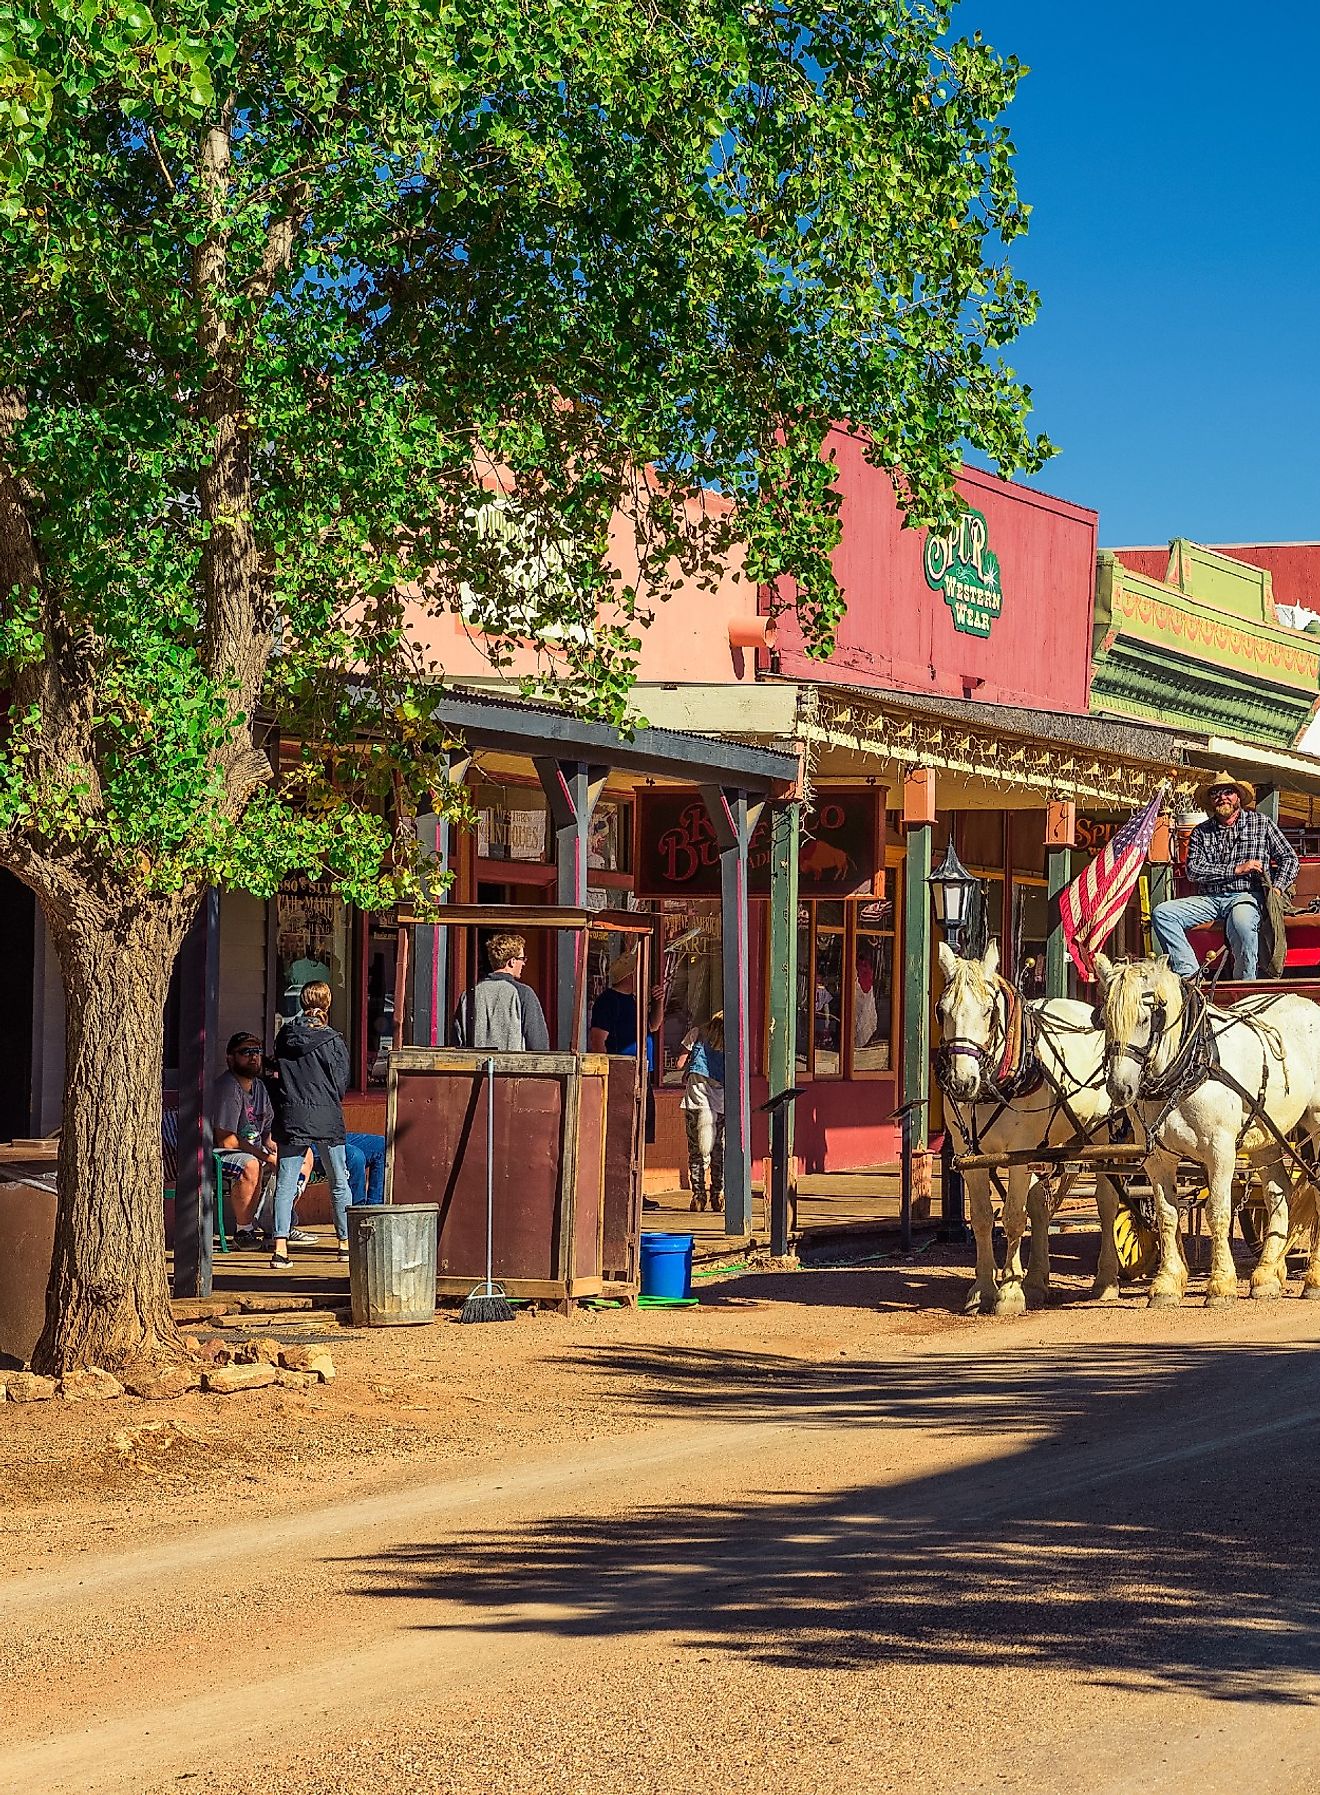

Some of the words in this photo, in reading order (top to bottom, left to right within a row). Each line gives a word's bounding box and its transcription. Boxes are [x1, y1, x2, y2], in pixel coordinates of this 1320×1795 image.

[927, 513, 986, 582] SPUR
[944, 575, 1001, 610] WESTERN
[955, 602, 990, 631] WEAR
